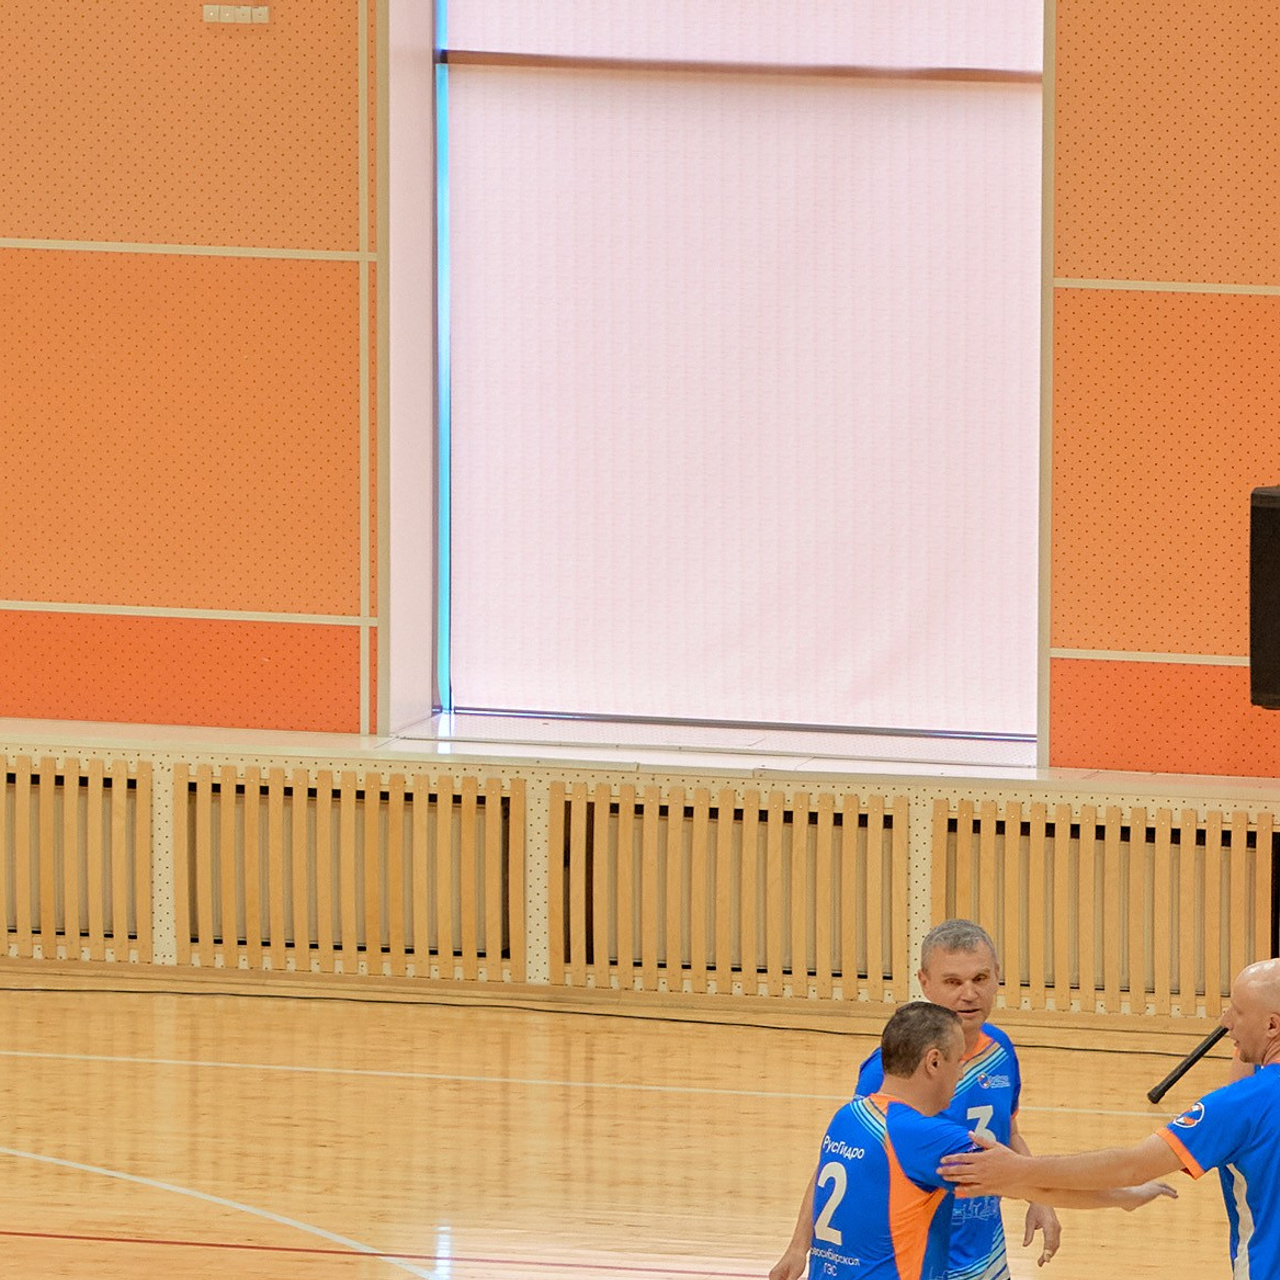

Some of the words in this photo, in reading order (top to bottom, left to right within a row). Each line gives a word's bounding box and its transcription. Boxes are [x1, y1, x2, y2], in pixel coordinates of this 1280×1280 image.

[822, 1135, 865, 1161] РусГидро
[814, 1161, 848, 1246] 2
[810, 1247, 861, 1266] овосибирская
[823, 1262, 838, 1277] ГЭС
